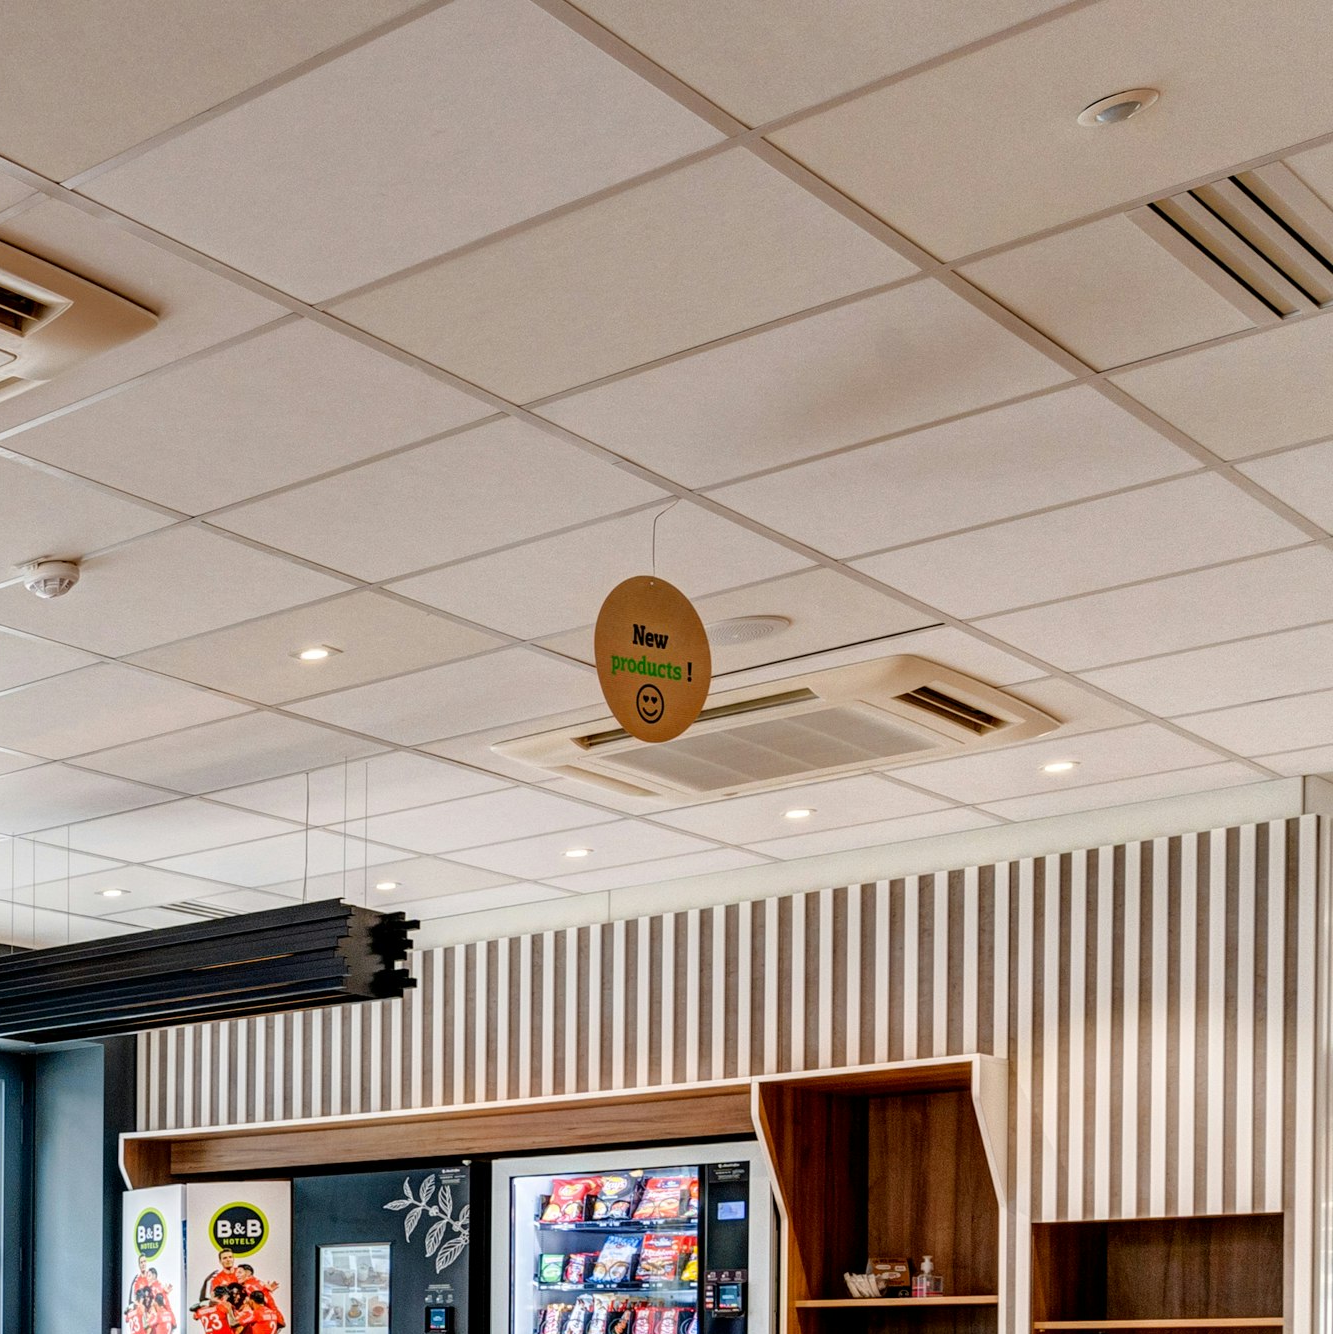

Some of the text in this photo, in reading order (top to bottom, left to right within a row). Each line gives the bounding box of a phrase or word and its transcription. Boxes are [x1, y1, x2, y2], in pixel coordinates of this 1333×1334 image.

[633, 624, 669, 649] New
[611, 655, 681, 680] products
[137, 1223, 163, 1243] B&B
[217, 1219, 262, 1238] B&B
[140, 1242, 159, 1250] HOTELS
[201, 1313, 223, 1332] 23
